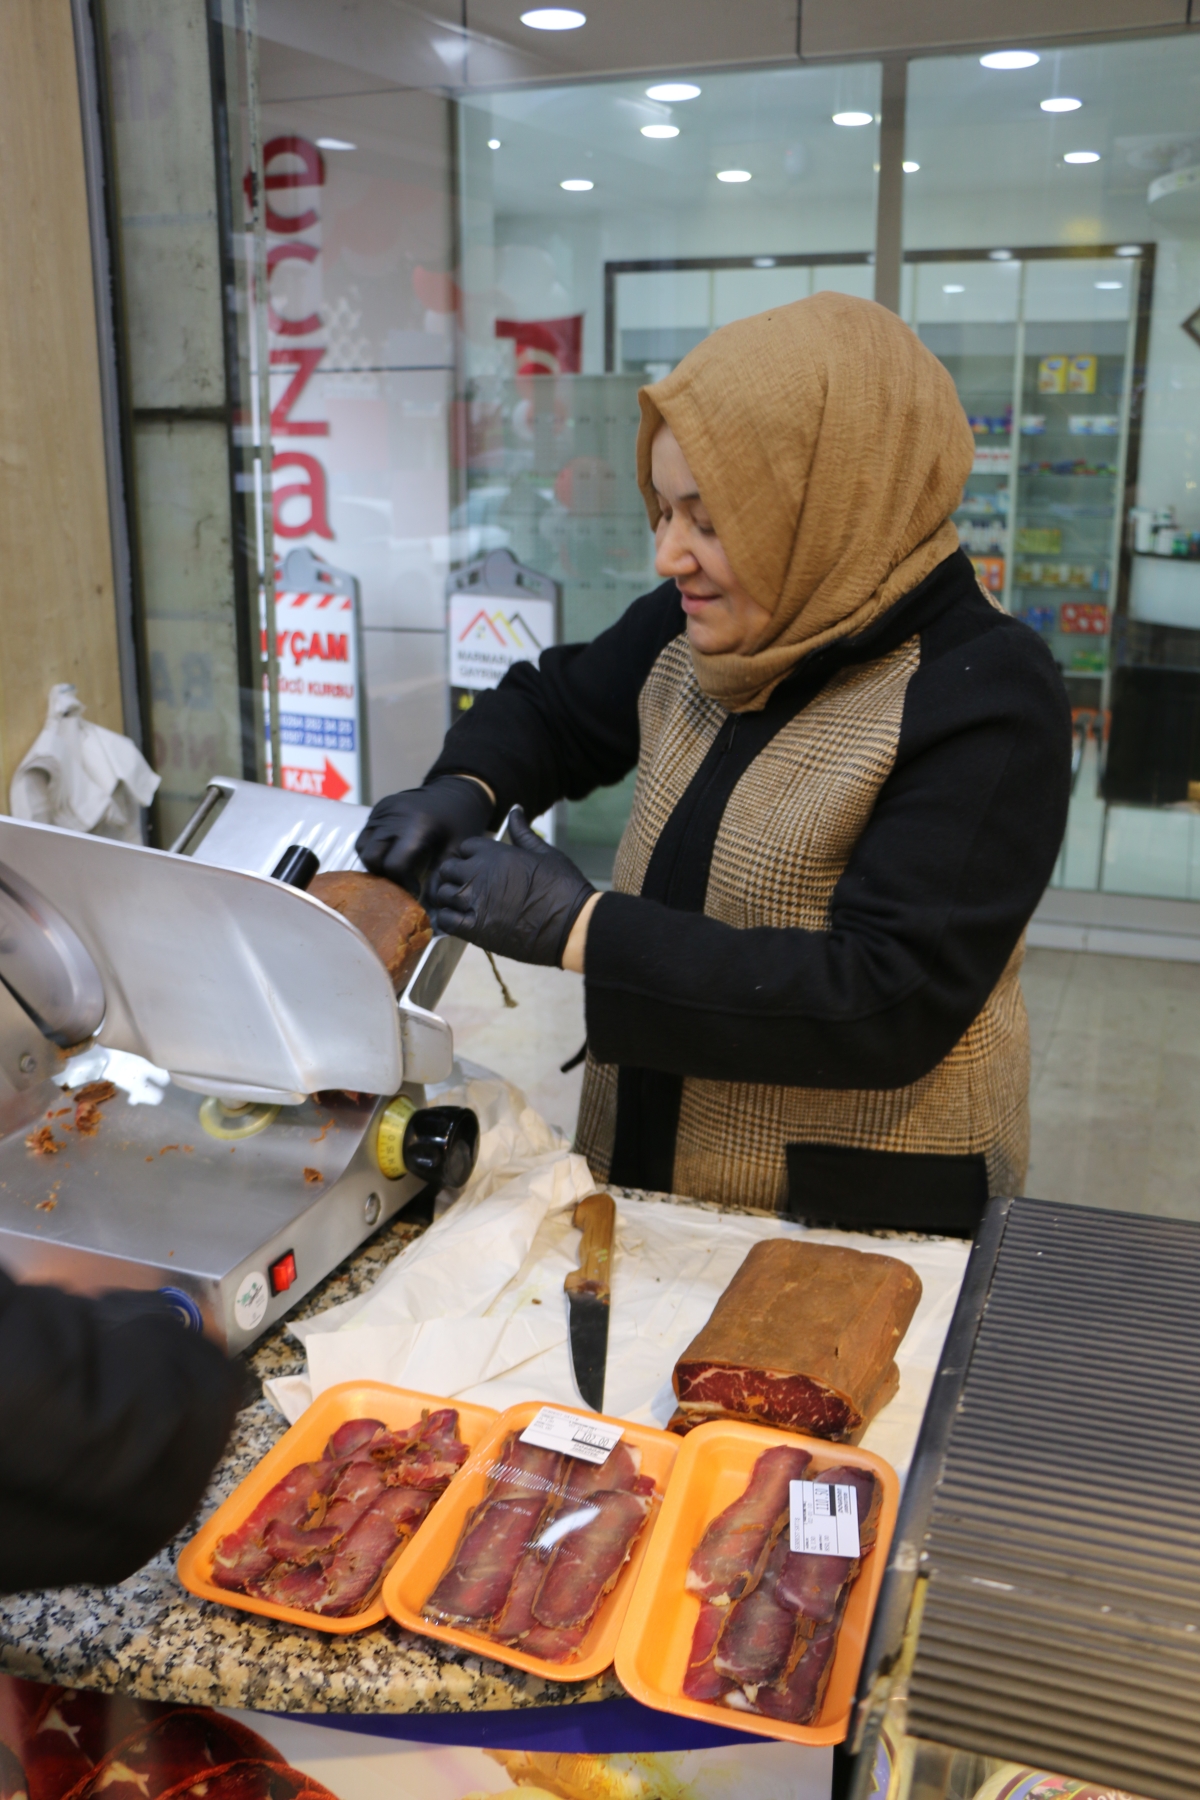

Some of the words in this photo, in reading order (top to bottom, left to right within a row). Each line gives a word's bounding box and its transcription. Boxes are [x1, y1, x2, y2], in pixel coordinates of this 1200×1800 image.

[243, 136, 334, 585] ecza
[260, 630, 349, 665] YÇAM
[286, 770, 325, 792] KAT
